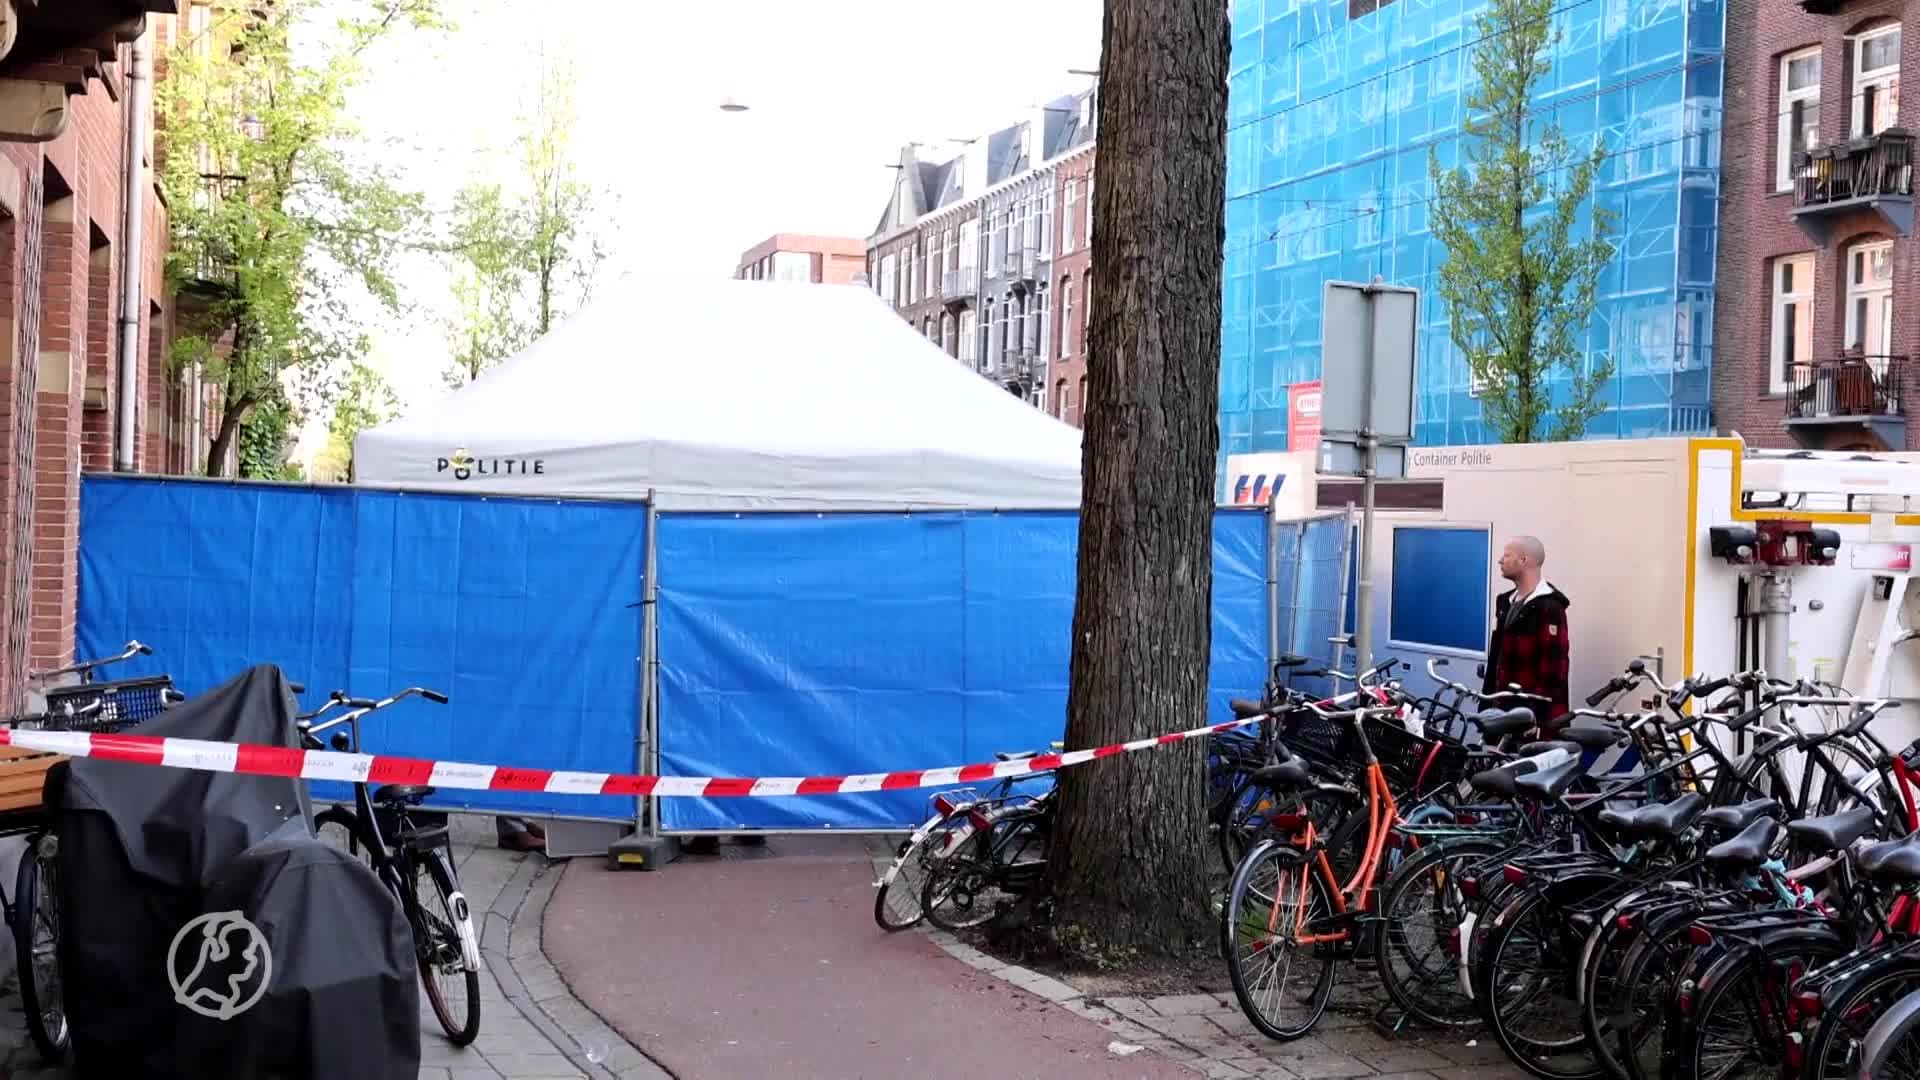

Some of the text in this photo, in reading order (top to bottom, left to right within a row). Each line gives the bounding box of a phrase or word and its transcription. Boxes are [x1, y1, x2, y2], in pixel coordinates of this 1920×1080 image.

[1414, 452, 1457, 466] Container
[1461, 450, 1492, 465] Politie
[437, 457, 544, 480] POLITIE
